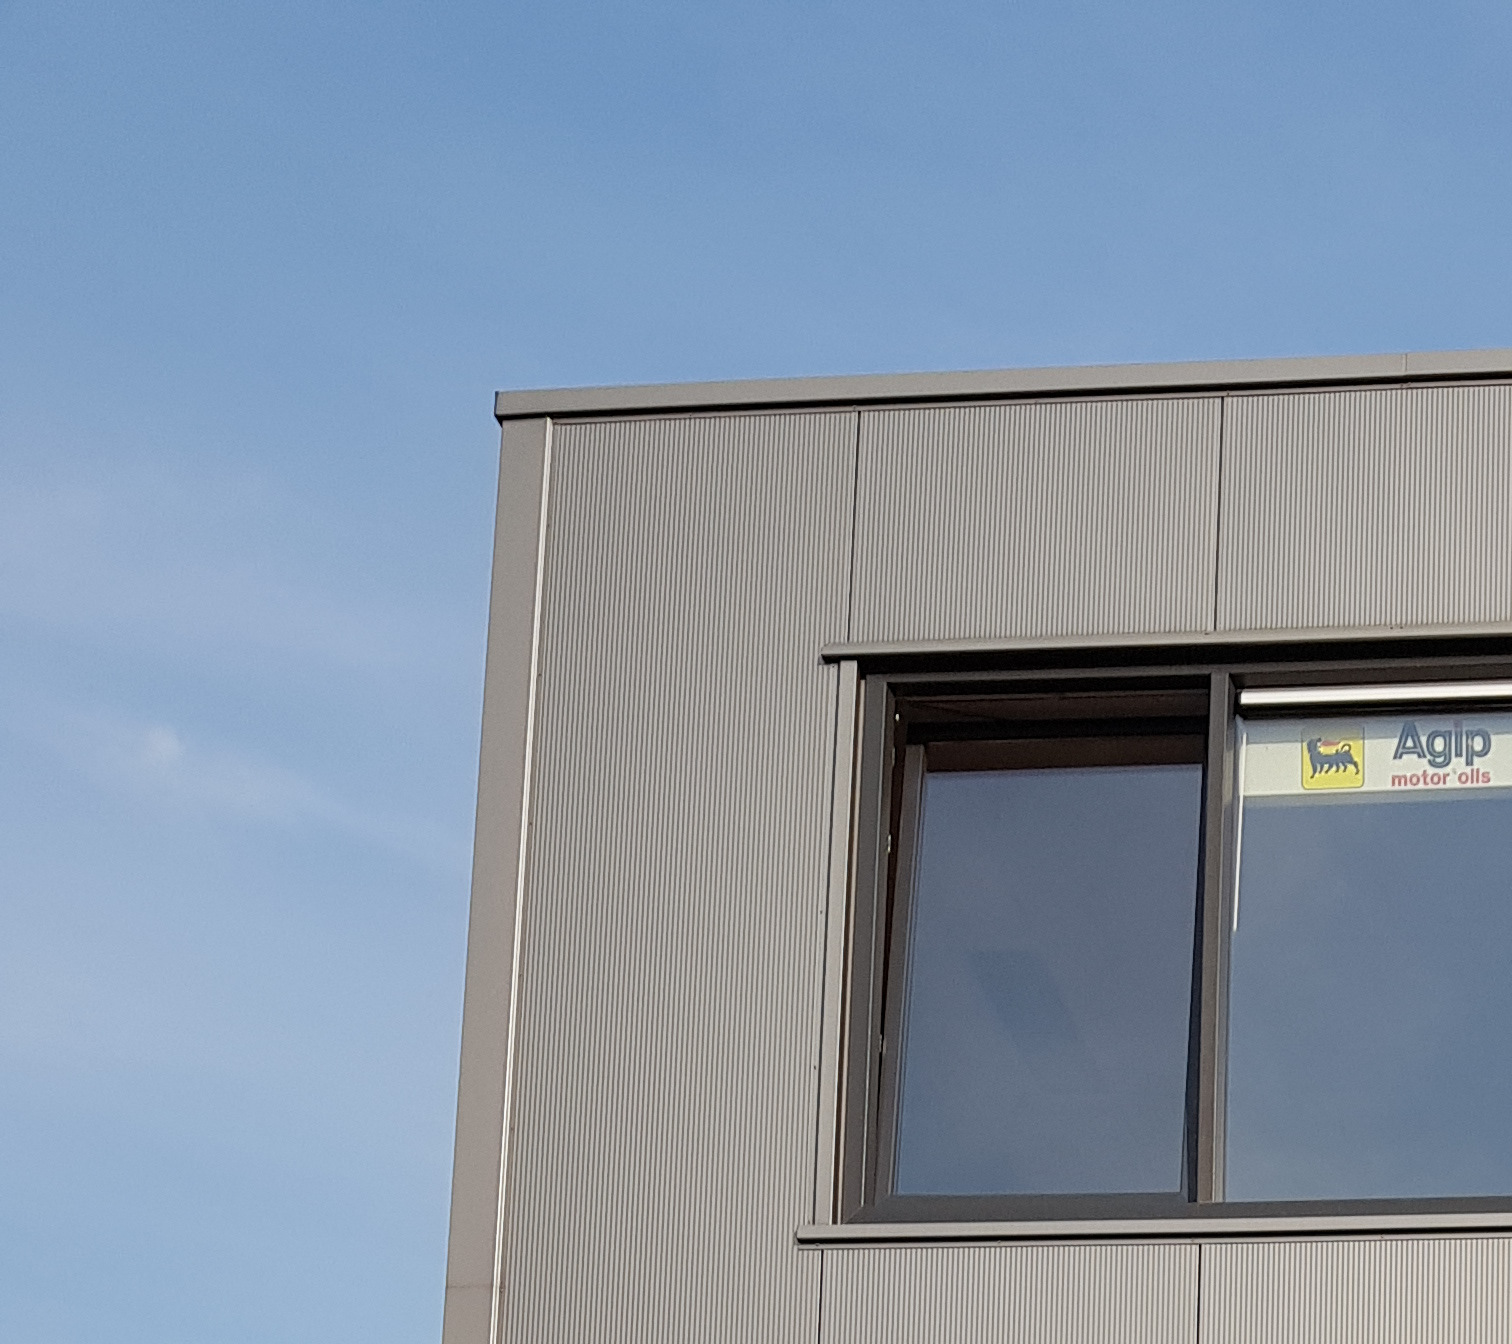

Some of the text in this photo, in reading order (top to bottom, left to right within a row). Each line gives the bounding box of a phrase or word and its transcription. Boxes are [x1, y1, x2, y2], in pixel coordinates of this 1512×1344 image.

[1392, 720, 1491, 768] Agip
[1391, 767, 1491, 787] motor oils
